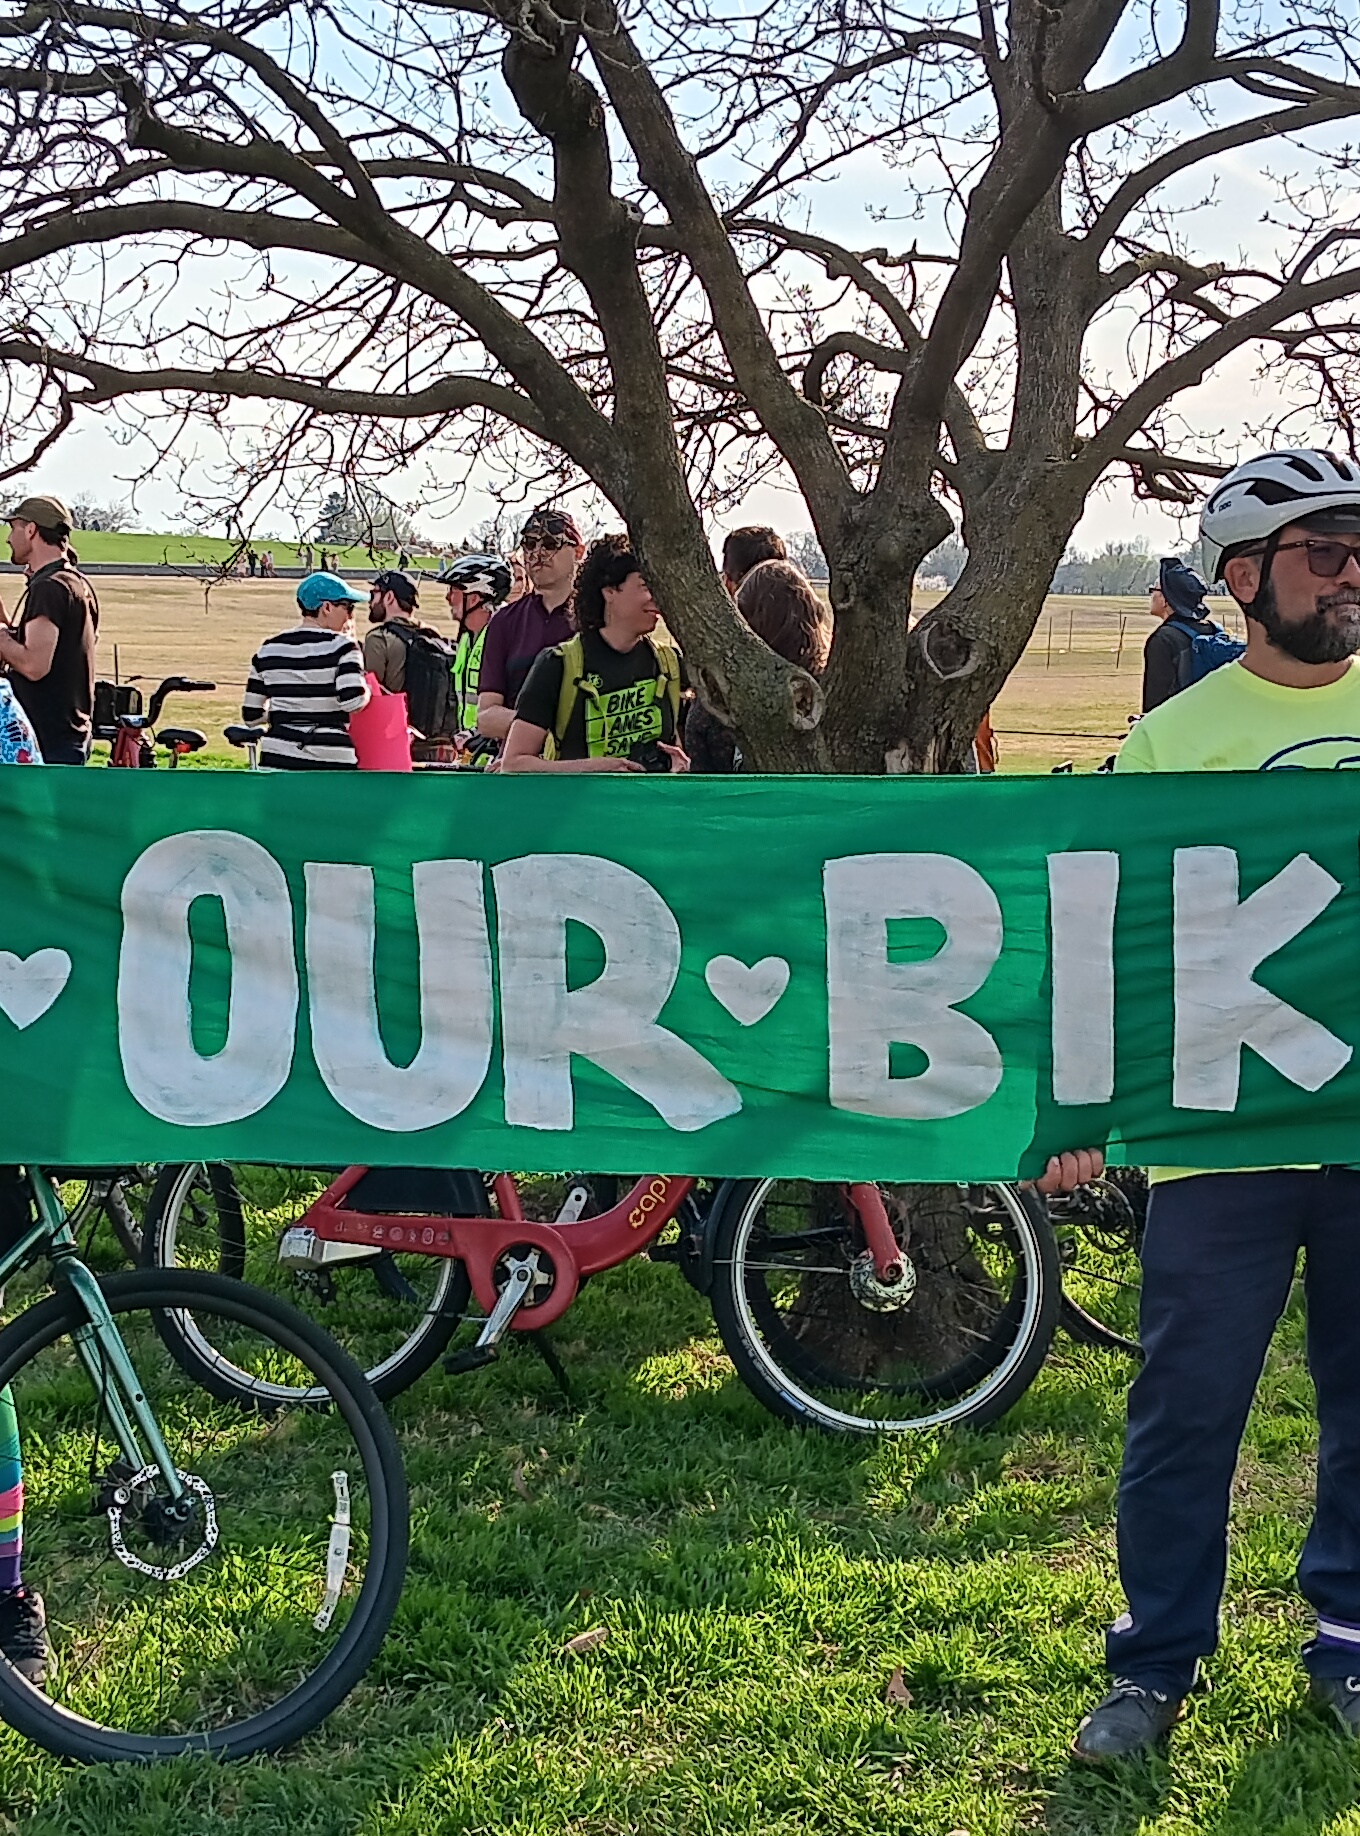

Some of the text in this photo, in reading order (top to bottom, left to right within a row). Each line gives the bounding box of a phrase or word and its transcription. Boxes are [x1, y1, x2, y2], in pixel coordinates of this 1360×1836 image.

[607, 686, 646, 714] BIKE
[118, 829, 743, 1132] OUR
[629, 1174, 672, 1229] cap
